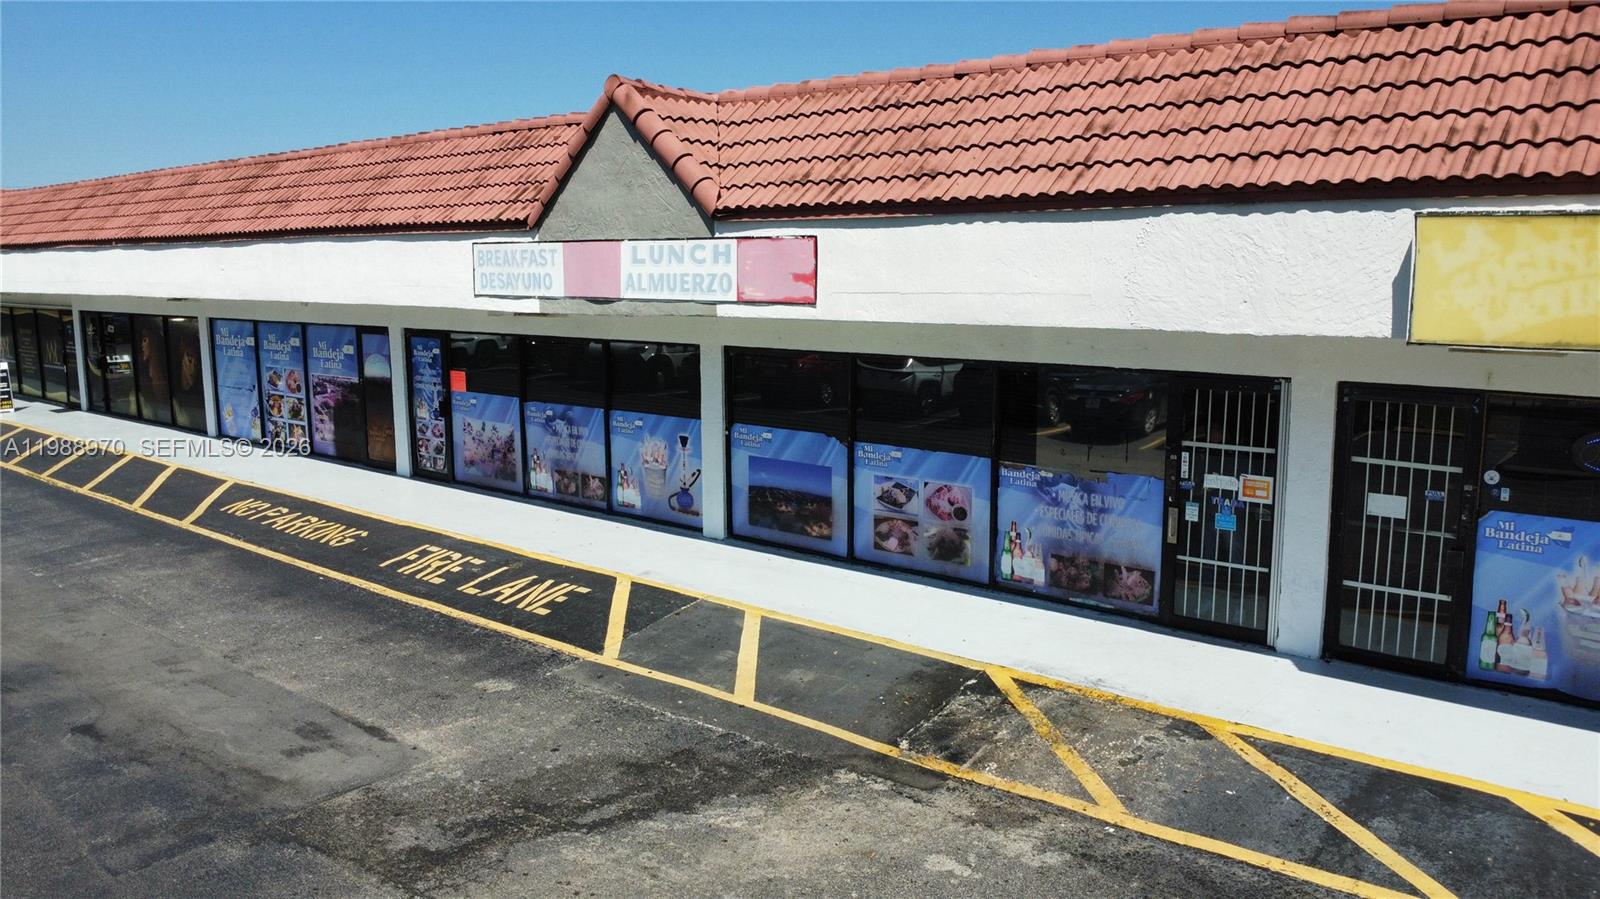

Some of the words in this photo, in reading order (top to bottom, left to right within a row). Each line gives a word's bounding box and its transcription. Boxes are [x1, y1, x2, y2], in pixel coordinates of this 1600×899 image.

[477, 249, 557, 268] BREAKFAST
[631, 243, 732, 266] LUNCH
[480, 272, 553, 290] DESAYUNO
[625, 272, 733, 293] ALMUERZO
[220, 327, 229, 337] Mi
[267, 334, 276, 342] Mi
[215, 334, 246, 349] Bandeja
[263, 339, 291, 354] Bandeja
[318, 341, 327, 350] Mi
[223, 346, 244, 358] Latina
[270, 351, 290, 361] Latina
[312, 347, 345, 361] Bandeja
[320, 359, 342, 370] Latina
[734, 432, 763, 443] Bandeja
[740, 440, 762, 448] Latina
[858, 449, 891, 462] Bandeja
[864, 458, 888, 468] Latina
[1001, 467, 1041, 481] Bandeja
[1009, 477, 1037, 488] Latina
[219, 498, 272, 517] NO
[248, 506, 369, 547] PARKING
[1498, 520, 1515, 531] Mi
[1485, 527, 1550, 546] Bandeja
[1498, 539, 1543, 554] Latina
[378, 544, 486, 584] FIRE
[456, 566, 593, 616] LANE
